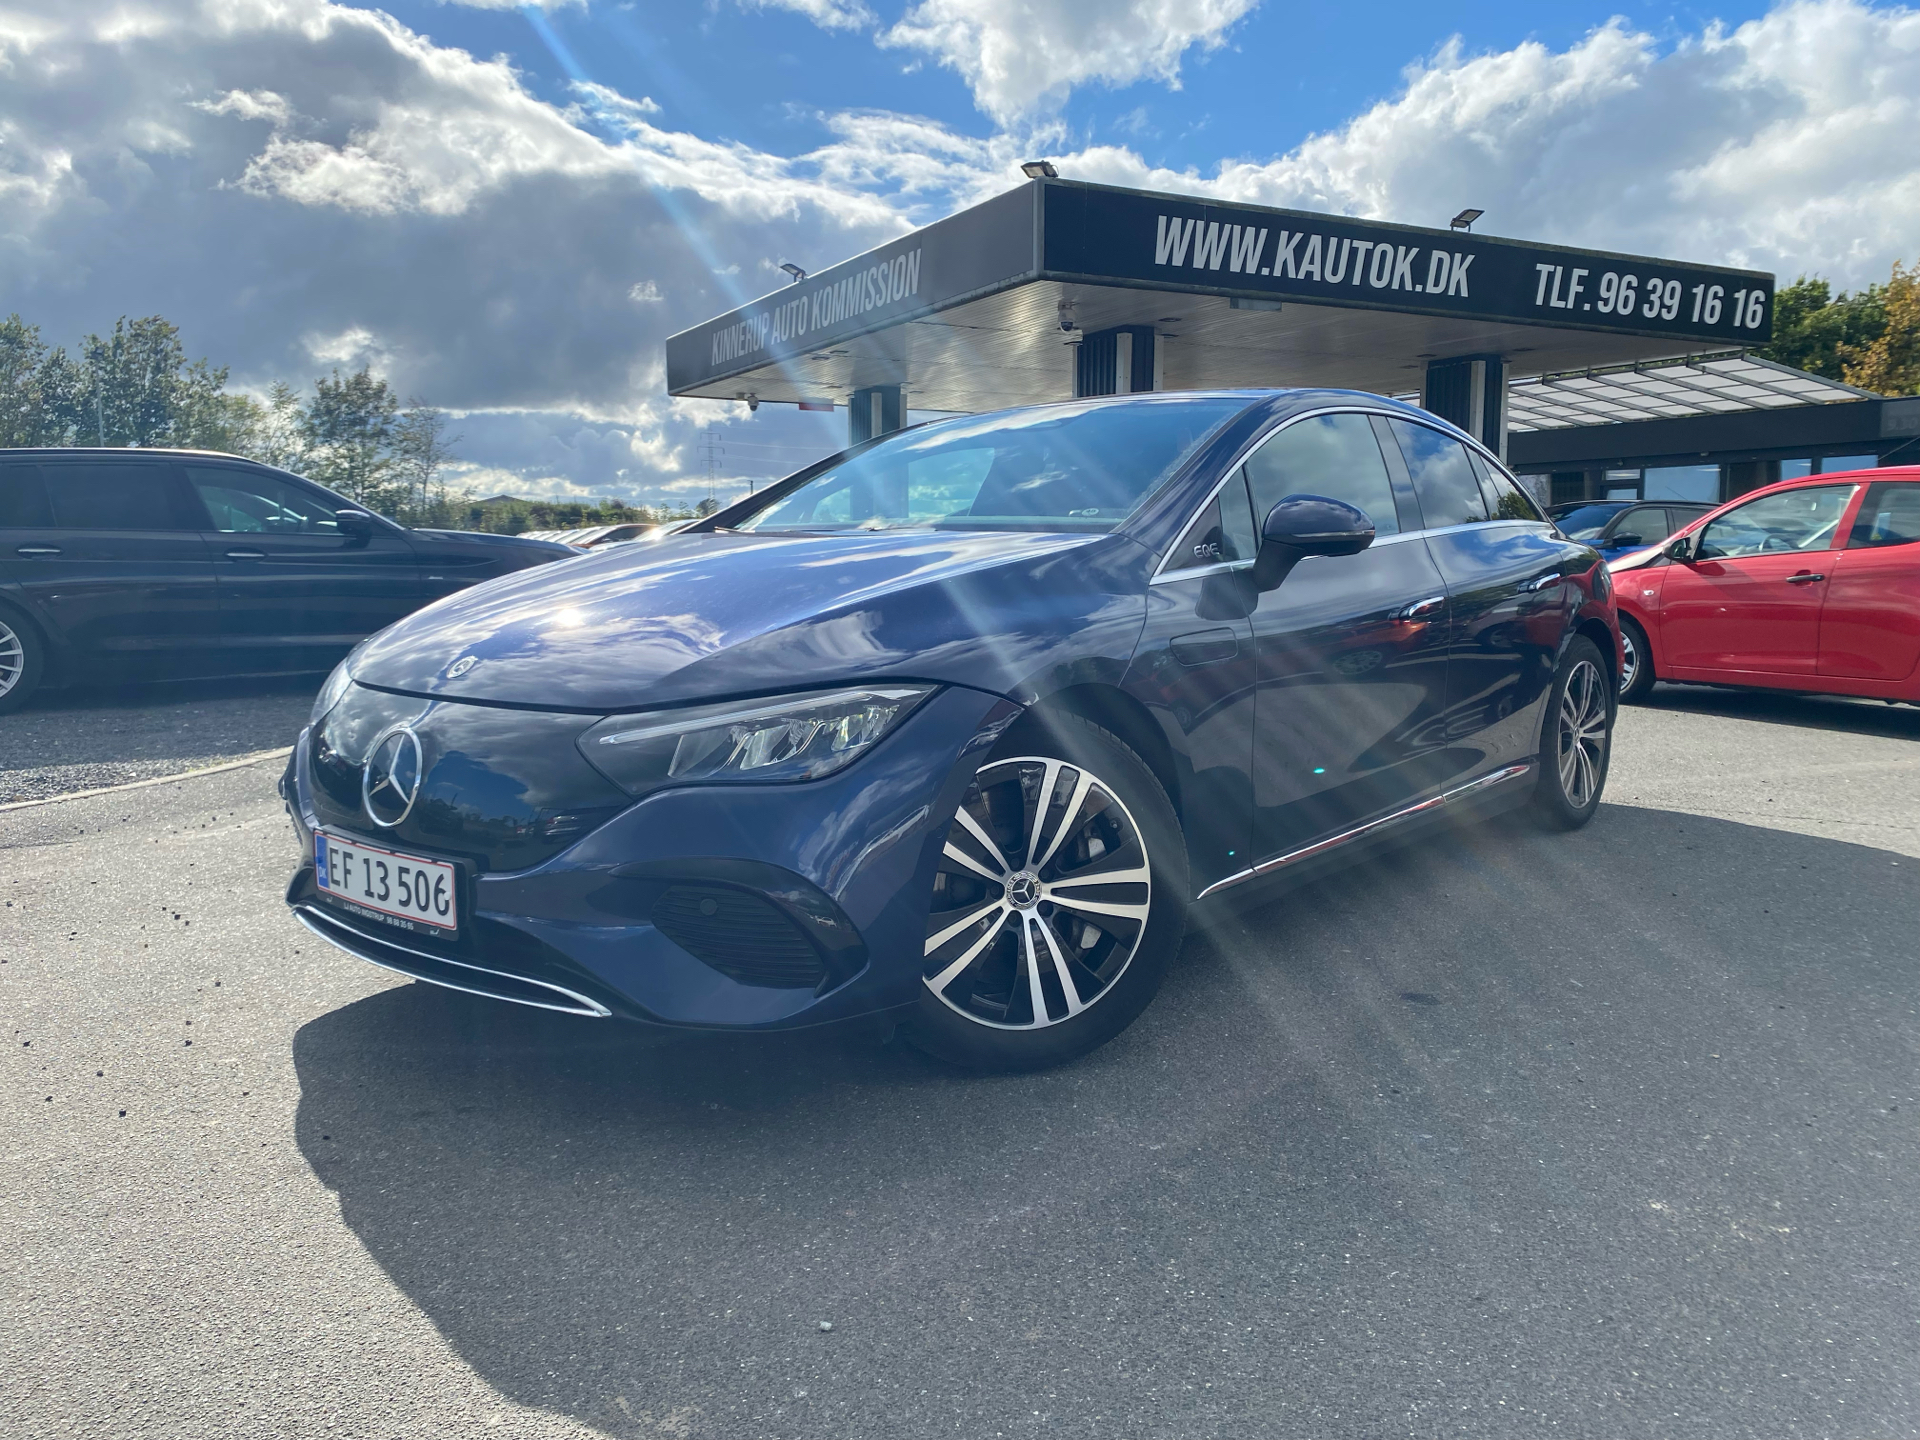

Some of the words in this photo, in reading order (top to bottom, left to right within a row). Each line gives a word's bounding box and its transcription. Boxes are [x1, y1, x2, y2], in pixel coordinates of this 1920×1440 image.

[1154, 214, 1476, 298] WWW.KAUTOK.DK
[711, 312, 770, 366] KINNERUP
[771, 295, 809, 345] AUTO
[811, 248, 922, 332] KOMMISSION
[1535, 263, 1590, 311] TLF.
[1597, 271, 1639, 315] 96
[1642, 277, 1682, 321] 39
[1691, 283, 1725, 325] 16
[1733, 288, 1766, 330] 16
[1193, 542, 1220, 558] EQE
[329, 847, 354, 889] EF
[363, 858, 390, 901] 13
[397, 866, 450, 916] 506
